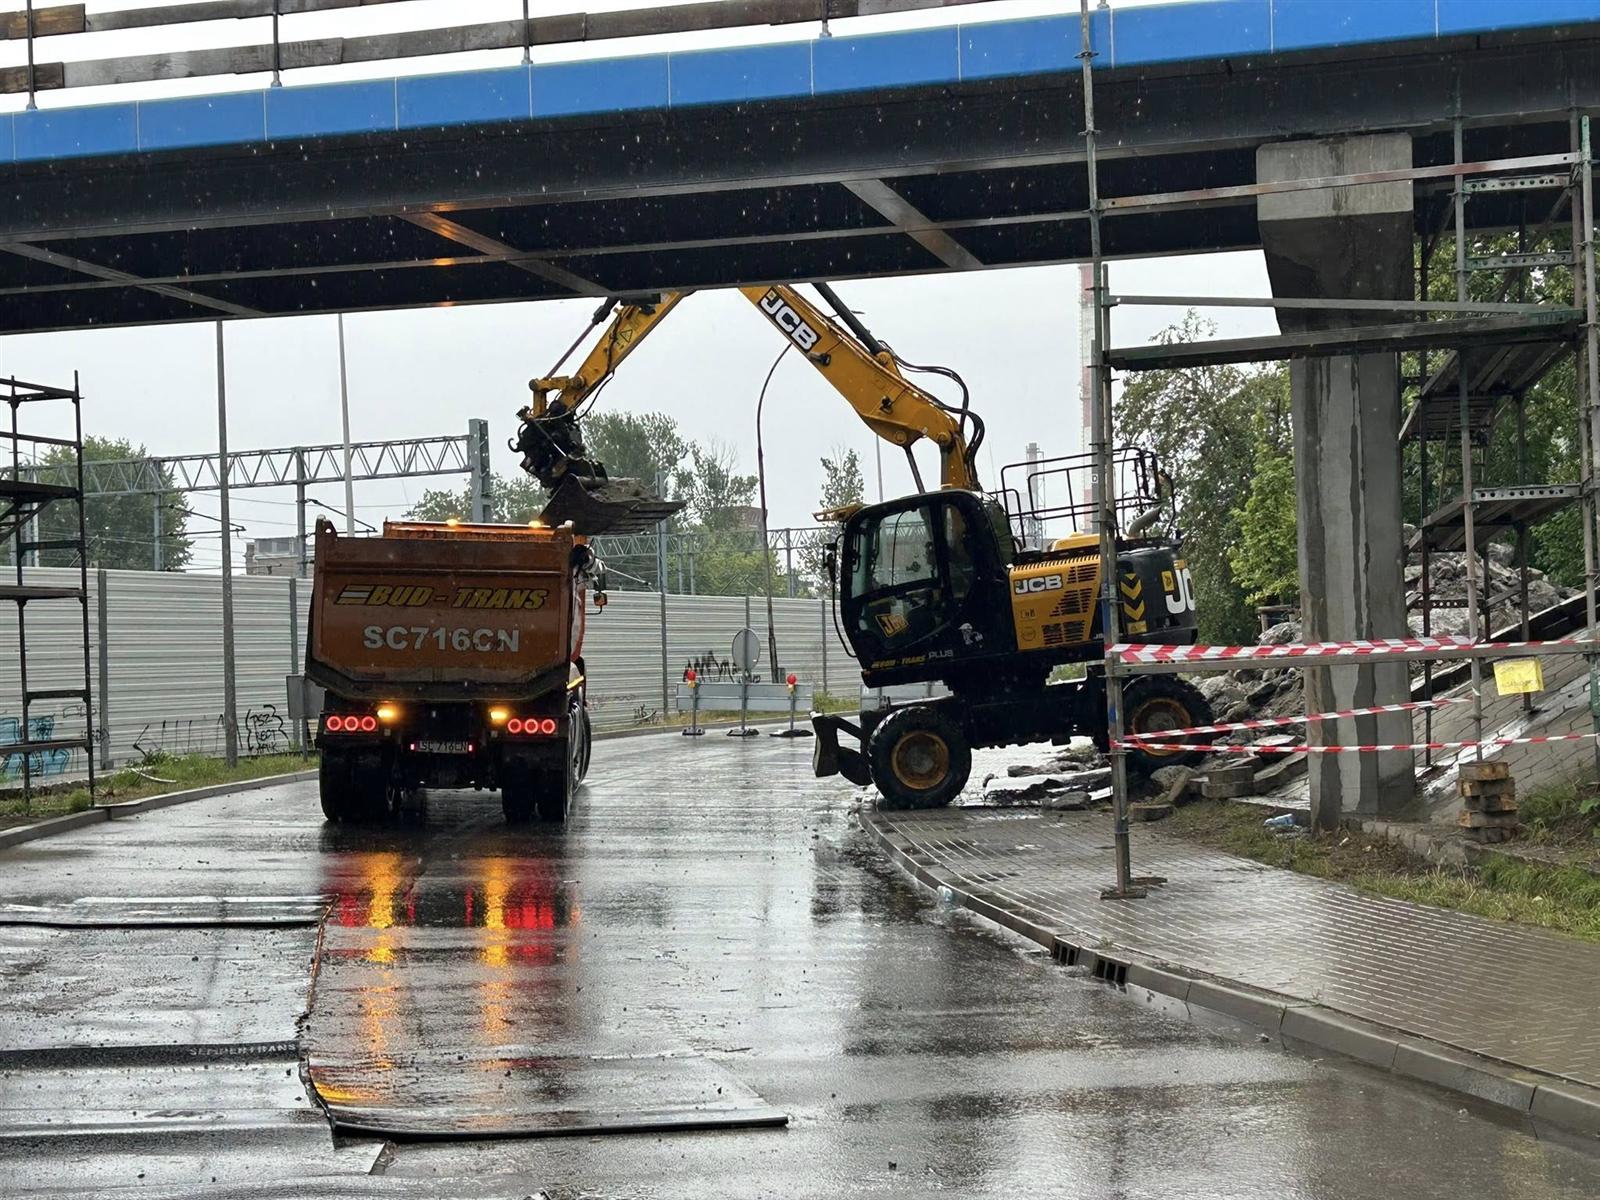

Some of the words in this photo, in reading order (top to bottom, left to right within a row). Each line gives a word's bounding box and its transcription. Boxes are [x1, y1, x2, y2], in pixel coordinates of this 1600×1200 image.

[760, 293, 818, 350] JCB
[1014, 574, 1063, 594] JCB
[452, 587, 548, 609] TRANS
[364, 625, 520, 651] SC716CN
